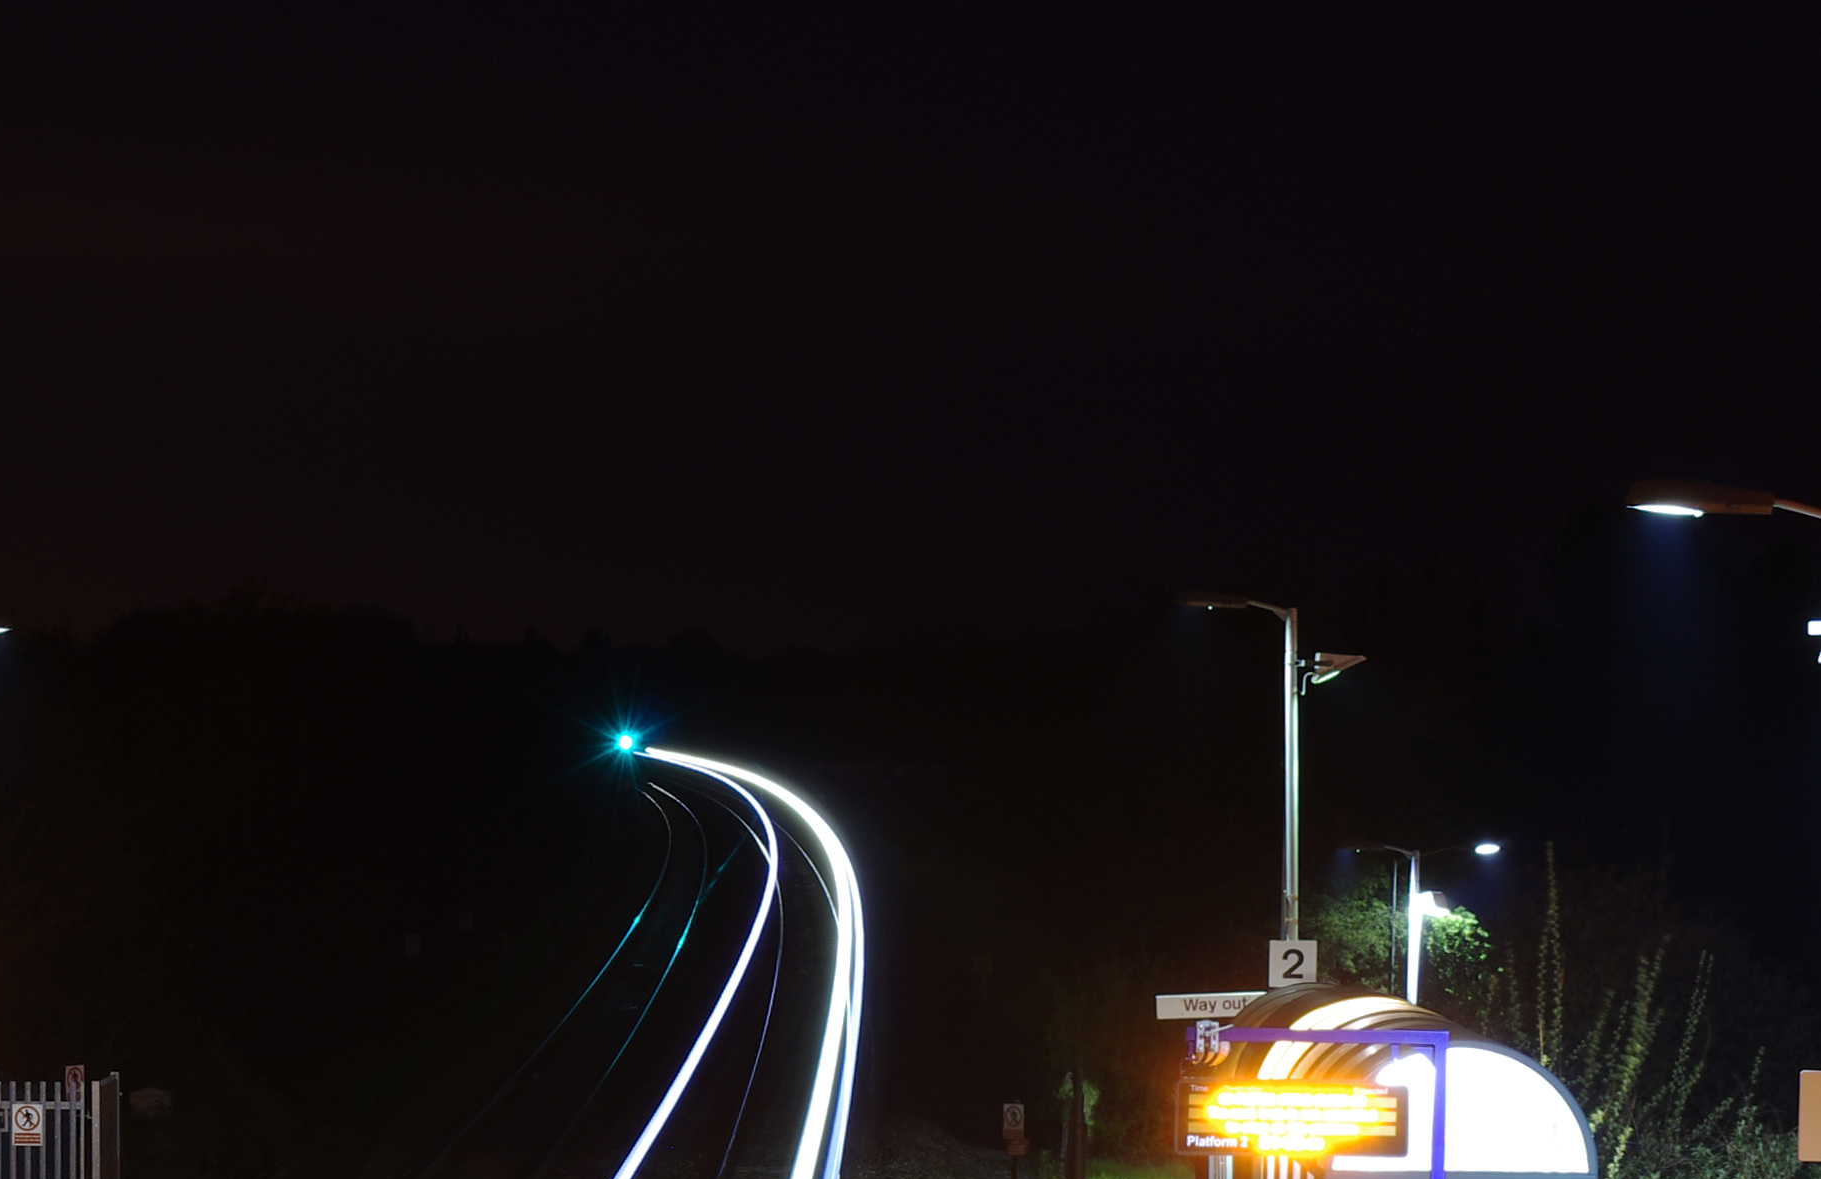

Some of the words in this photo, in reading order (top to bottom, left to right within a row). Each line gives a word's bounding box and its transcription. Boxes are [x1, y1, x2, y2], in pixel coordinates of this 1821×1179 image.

[1282, 949, 1304, 979] 2
[1183, 998, 1217, 1013] Way
[1222, 996, 1248, 1010] out
[1190, 1084, 1209, 1093] Time
[1186, 1135, 1237, 1148] Platform
[1240, 1135, 1248, 1148] 2
